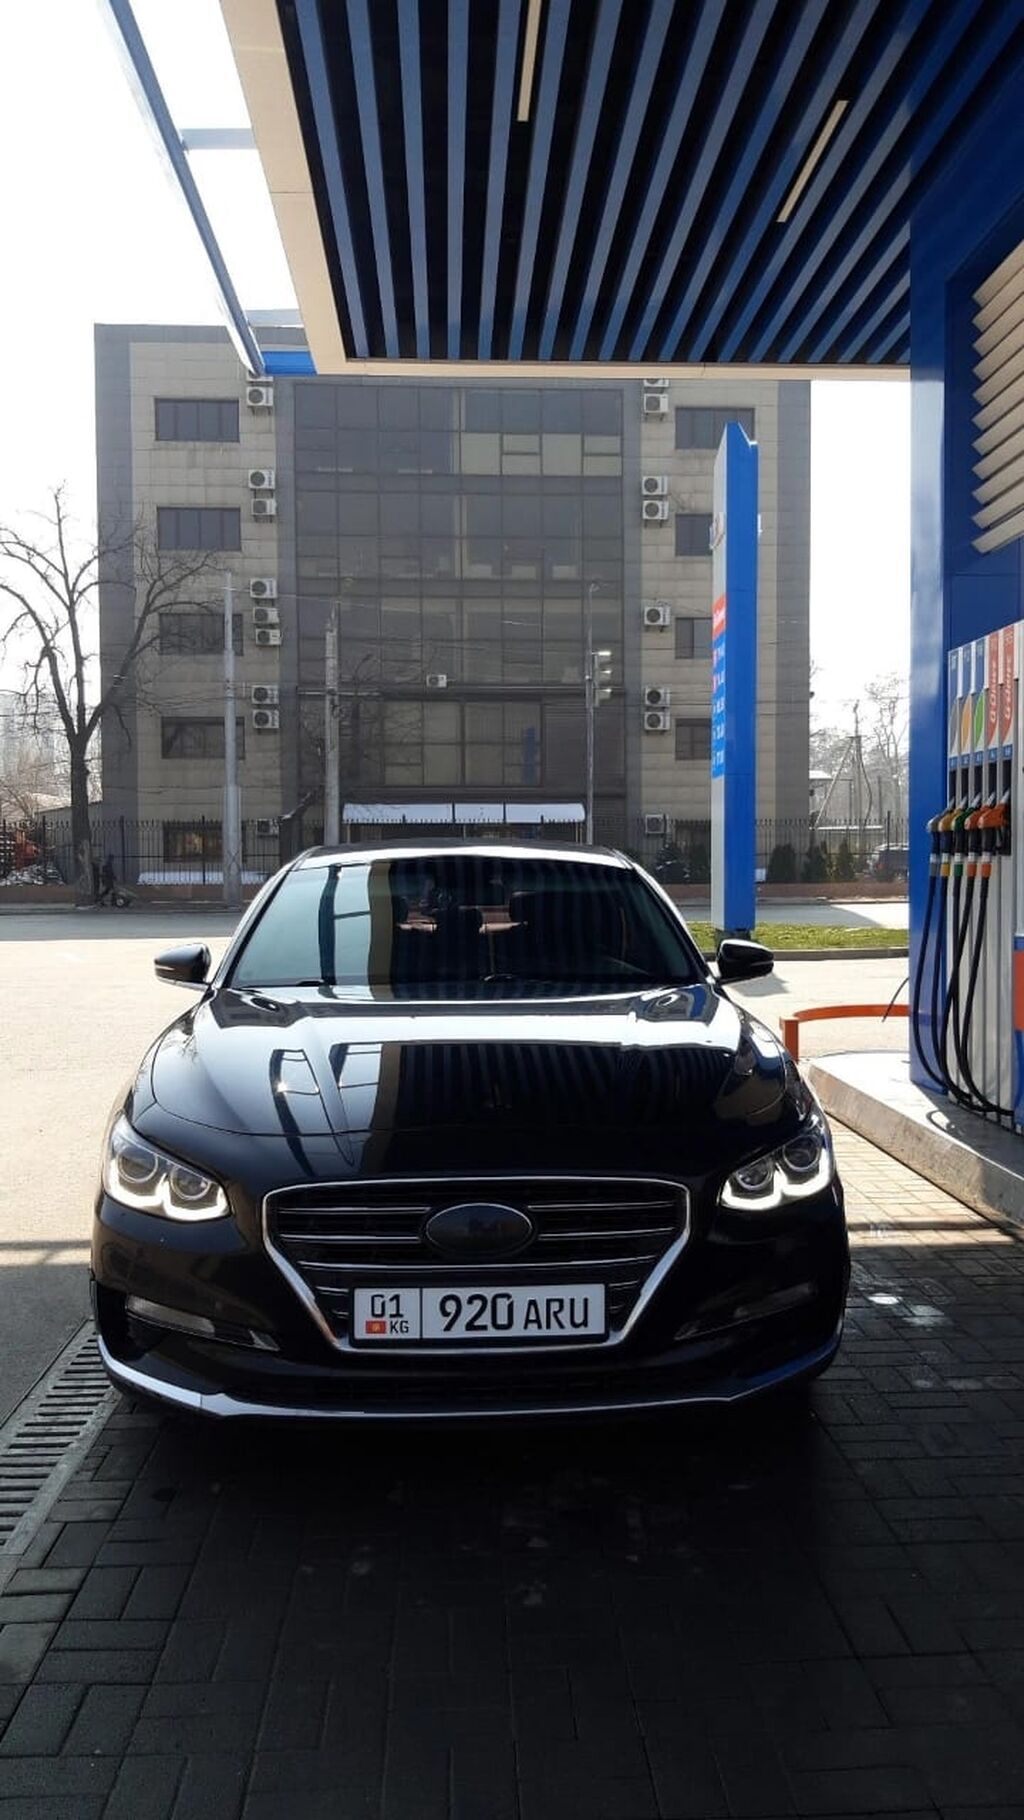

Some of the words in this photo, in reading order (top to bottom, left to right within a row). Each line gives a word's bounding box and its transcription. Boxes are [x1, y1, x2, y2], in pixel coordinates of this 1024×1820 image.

[370, 1294, 404, 1318] 01
[439, 1293, 514, 1332] 920
[523, 1297, 589, 1330] ARU
[389, 1320, 410, 1334] KG
